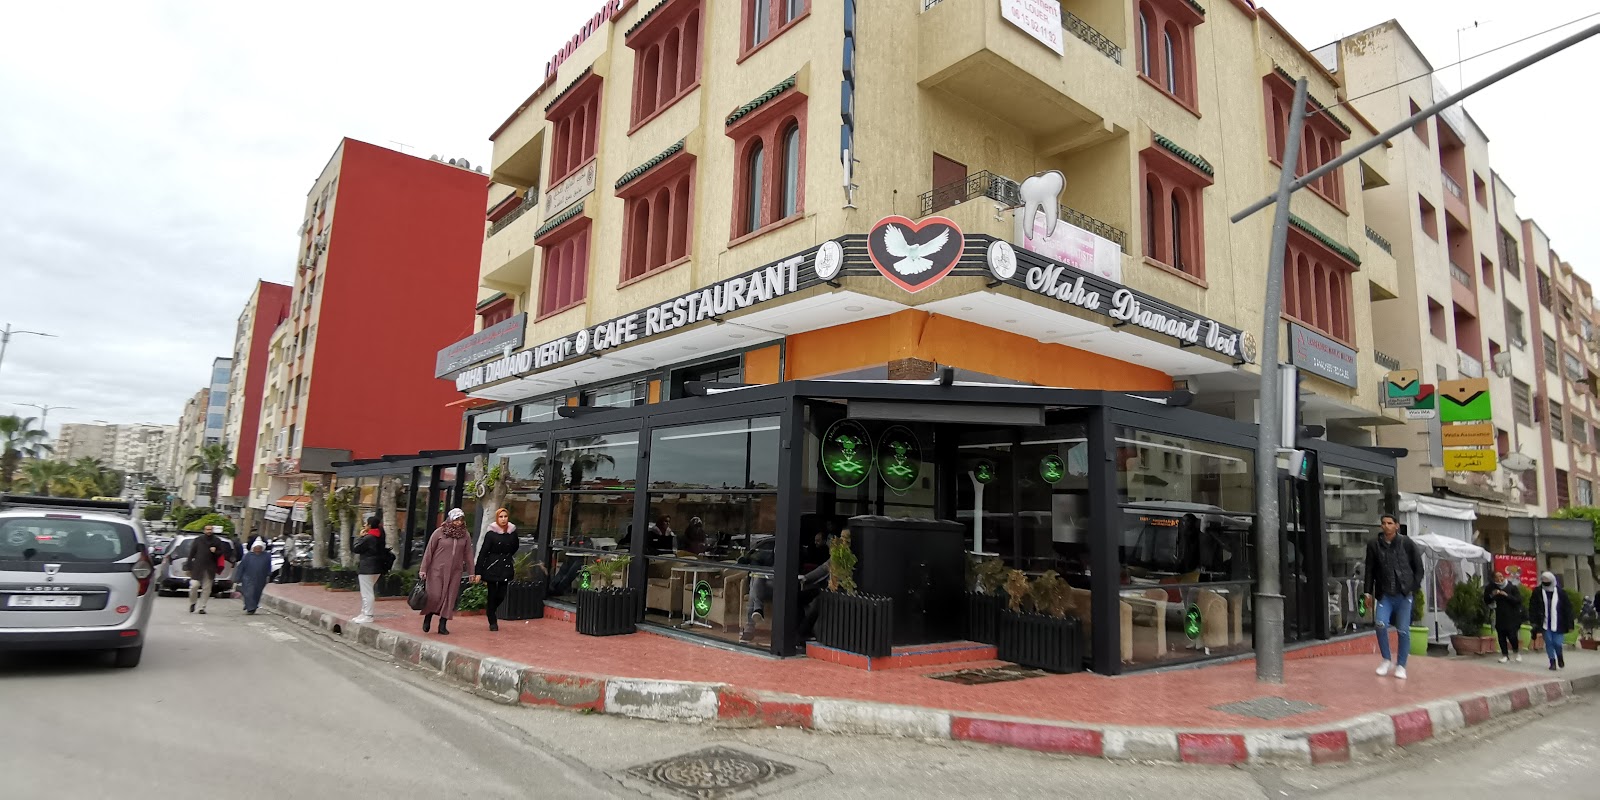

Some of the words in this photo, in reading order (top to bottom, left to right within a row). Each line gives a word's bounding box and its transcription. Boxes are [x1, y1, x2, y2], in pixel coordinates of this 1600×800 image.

[1011, 6, 1020, 19] 06
[1021, 14, 1030, 26] 15
[1030, 19, 1039, 32] 02
[1040, 26, 1047, 38] 11
[1024, 1, 1049, 24] LOUER
[593, 314, 639, 350] CAFE
[645, 255, 804, 336] RESTAURANT
[1025, 263, 1100, 310] Maha
[1108, 288, 1200, 343] Diamand
[1205, 320, 1237, 356] Vert
[456, 367, 483, 391] MAHA
[485, 350, 533, 383] DIAMAND
[534, 338, 568, 369] VERT
